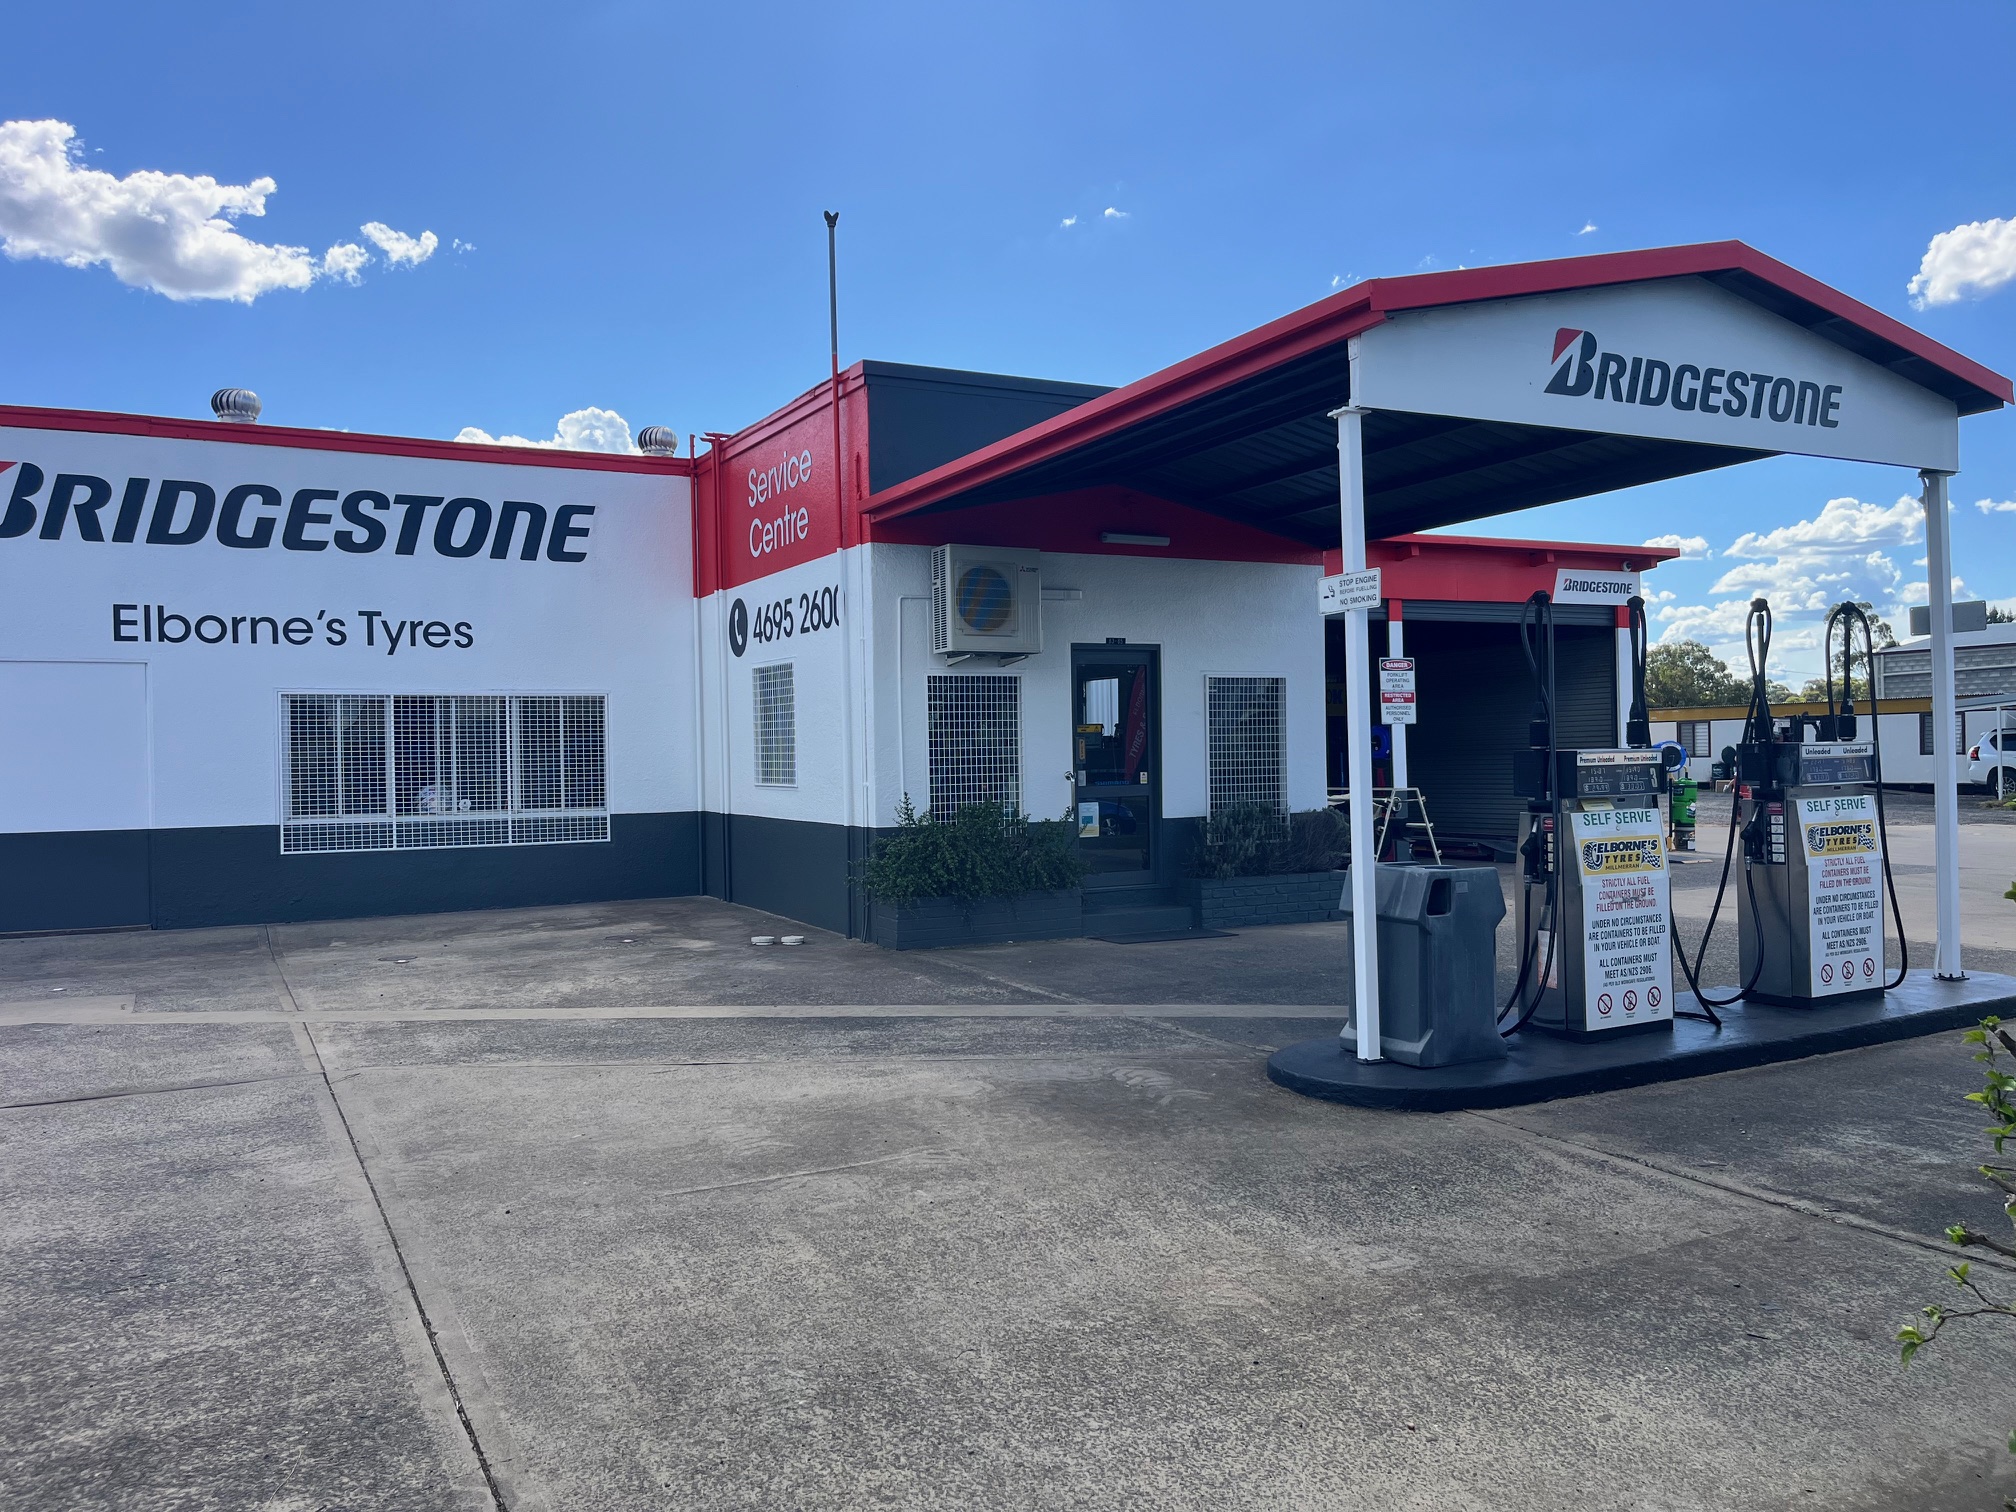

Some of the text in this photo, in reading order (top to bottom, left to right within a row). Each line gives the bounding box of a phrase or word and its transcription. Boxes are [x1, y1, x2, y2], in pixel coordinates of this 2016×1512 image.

[1544, 327, 1843, 428] BRIDGESTONE
[748, 449, 813, 508] Service
[0, 462, 595, 562] BRIDGESTONE
[749, 504, 810, 558] Centre
[1339, 574, 1377, 588] STOP ENGINE
[1562, 578, 1633, 595] BRIDGESTONE
[1340, 584, 1377, 595] BEFORE FUELLING
[1350, 593, 1377, 604] SMOKING
[753, 597, 794, 644] 4695
[113, 604, 474, 655] Elborne's Tyres
[1128, 730, 1145, 761] TYRES
[1597, 755, 1615, 763] Unleaded
[1649, 767, 1658, 788] 3
[1807, 798, 1866, 812] SELF SERVE
[1583, 810, 1652, 826] SELF SERVE
[1820, 823, 1871, 837] ELBORNE'S
[1597, 840, 1658, 854] ELBORNE'S
[1826, 836, 1857, 846] TYRES
[1604, 854, 1640, 864] TYRES
[1824, 858, 1844, 867] STRICTLY
[1854, 856, 1865, 864] FUEL
[1605, 863, 1640, 871] MILLMERRAN
[1822, 866, 1869, 878] CONTAINERS MUST BE
[1602, 876, 1650, 889] STRICTLY ALL FUEL
[1820, 880, 1835, 889] FILLED
[1836, 879, 1842, 887] ON
[1843, 878, 1852, 886] THE
[1599, 887, 1654, 900] CONTAINERS MUST BE
[1816, 890, 1875, 904] UNDER NO CIRCUMSTANCES
[1596, 899, 1657, 912] FILLED ON THE GROUND.
[1813, 906, 1822, 915] ARE
[1823, 903, 1850, 915] CONTAINERS
[1858, 902, 1864, 910] BE
[1864, 900, 1879, 909] FILLED
[1592, 914, 1662, 929] UNDER NO CIRCUMSTANCES
[1818, 917, 1823, 925] IN
[1824, 915, 1836, 925] YOUR
[1837, 913, 1856, 923] VEHICLE
[1863, 911, 1874, 920] BOAT.
[1588, 925, 1666, 941] ARE CONTAINERS TO BE FILLED
[1822, 926, 1872, 940] ALL CONTAINERS MUST
[1593, 936, 1661, 952] IN YOUR VEHICLE OR BOAT.
[1826, 941, 1839, 950] MEET
[1599, 953, 1658, 968] ALL CONTAINERS MUST
[1604, 966, 1653, 979] MEET AS/NZS 2906.
